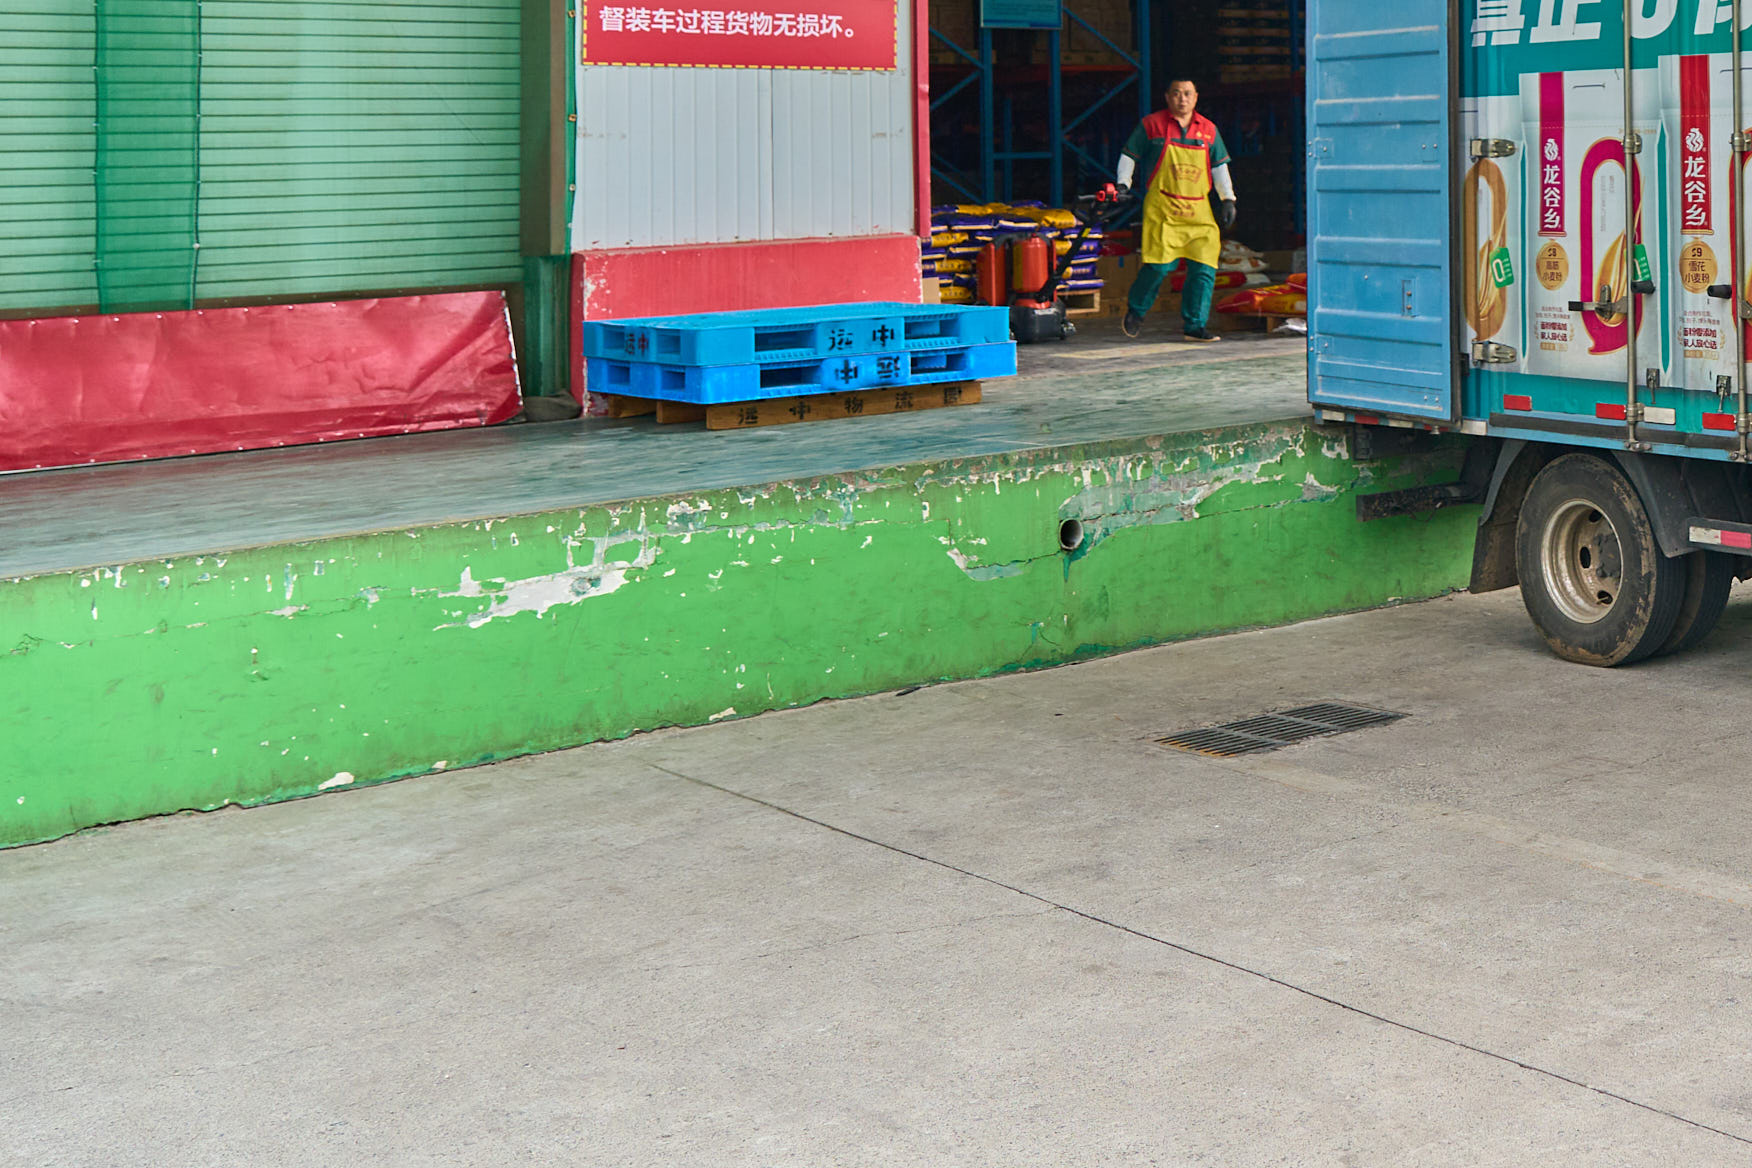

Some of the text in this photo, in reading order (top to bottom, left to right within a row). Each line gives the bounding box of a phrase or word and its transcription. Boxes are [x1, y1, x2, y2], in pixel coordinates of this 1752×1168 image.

[598, 6, 857, 40] 督装车过程货物无损坏。
[1543, 164, 1561, 229] 龙谷乡
[1684, 156, 1707, 226] 龙谷乡
[1684, 273, 1710, 284] 小麦粉
[1688, 261, 1706, 272] 雪花
